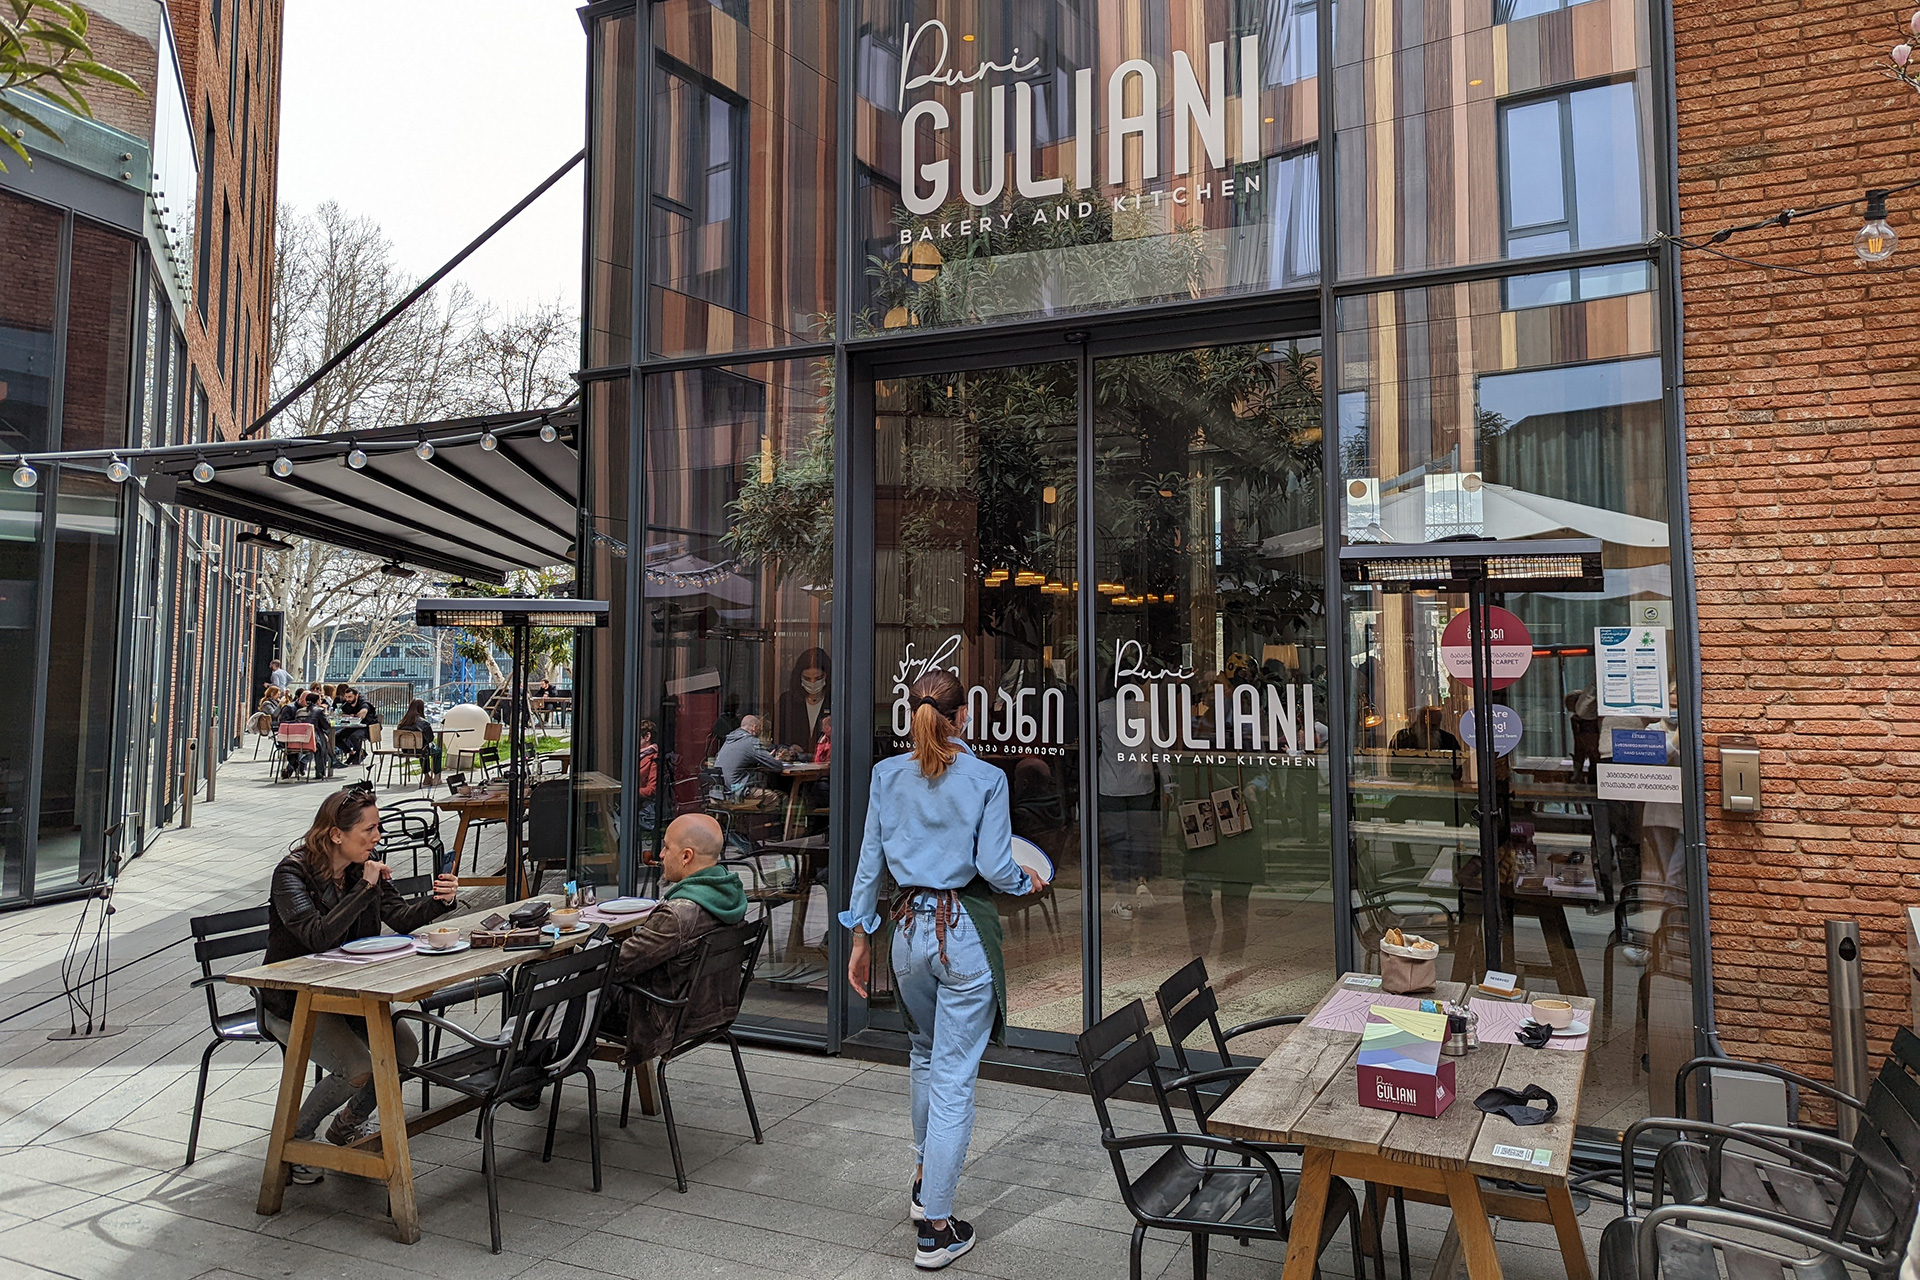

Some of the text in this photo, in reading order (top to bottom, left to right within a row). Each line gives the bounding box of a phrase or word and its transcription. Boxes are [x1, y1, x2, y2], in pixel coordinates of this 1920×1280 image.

[898, 19, 1040, 113] Puri
[901, 34, 1260, 216] GULIANI
[900, 174, 1261, 245] BAKERY AND KITCHEN
[1114, 638, 1195, 689] Puri
[891, 683, 1064, 745] გიანი
[1116, 683, 1315, 751] GULIANI
[1117, 752, 1316, 767] BAKERY AND KITCHEN
[1376, 1084, 1417, 1104] GULIANI
